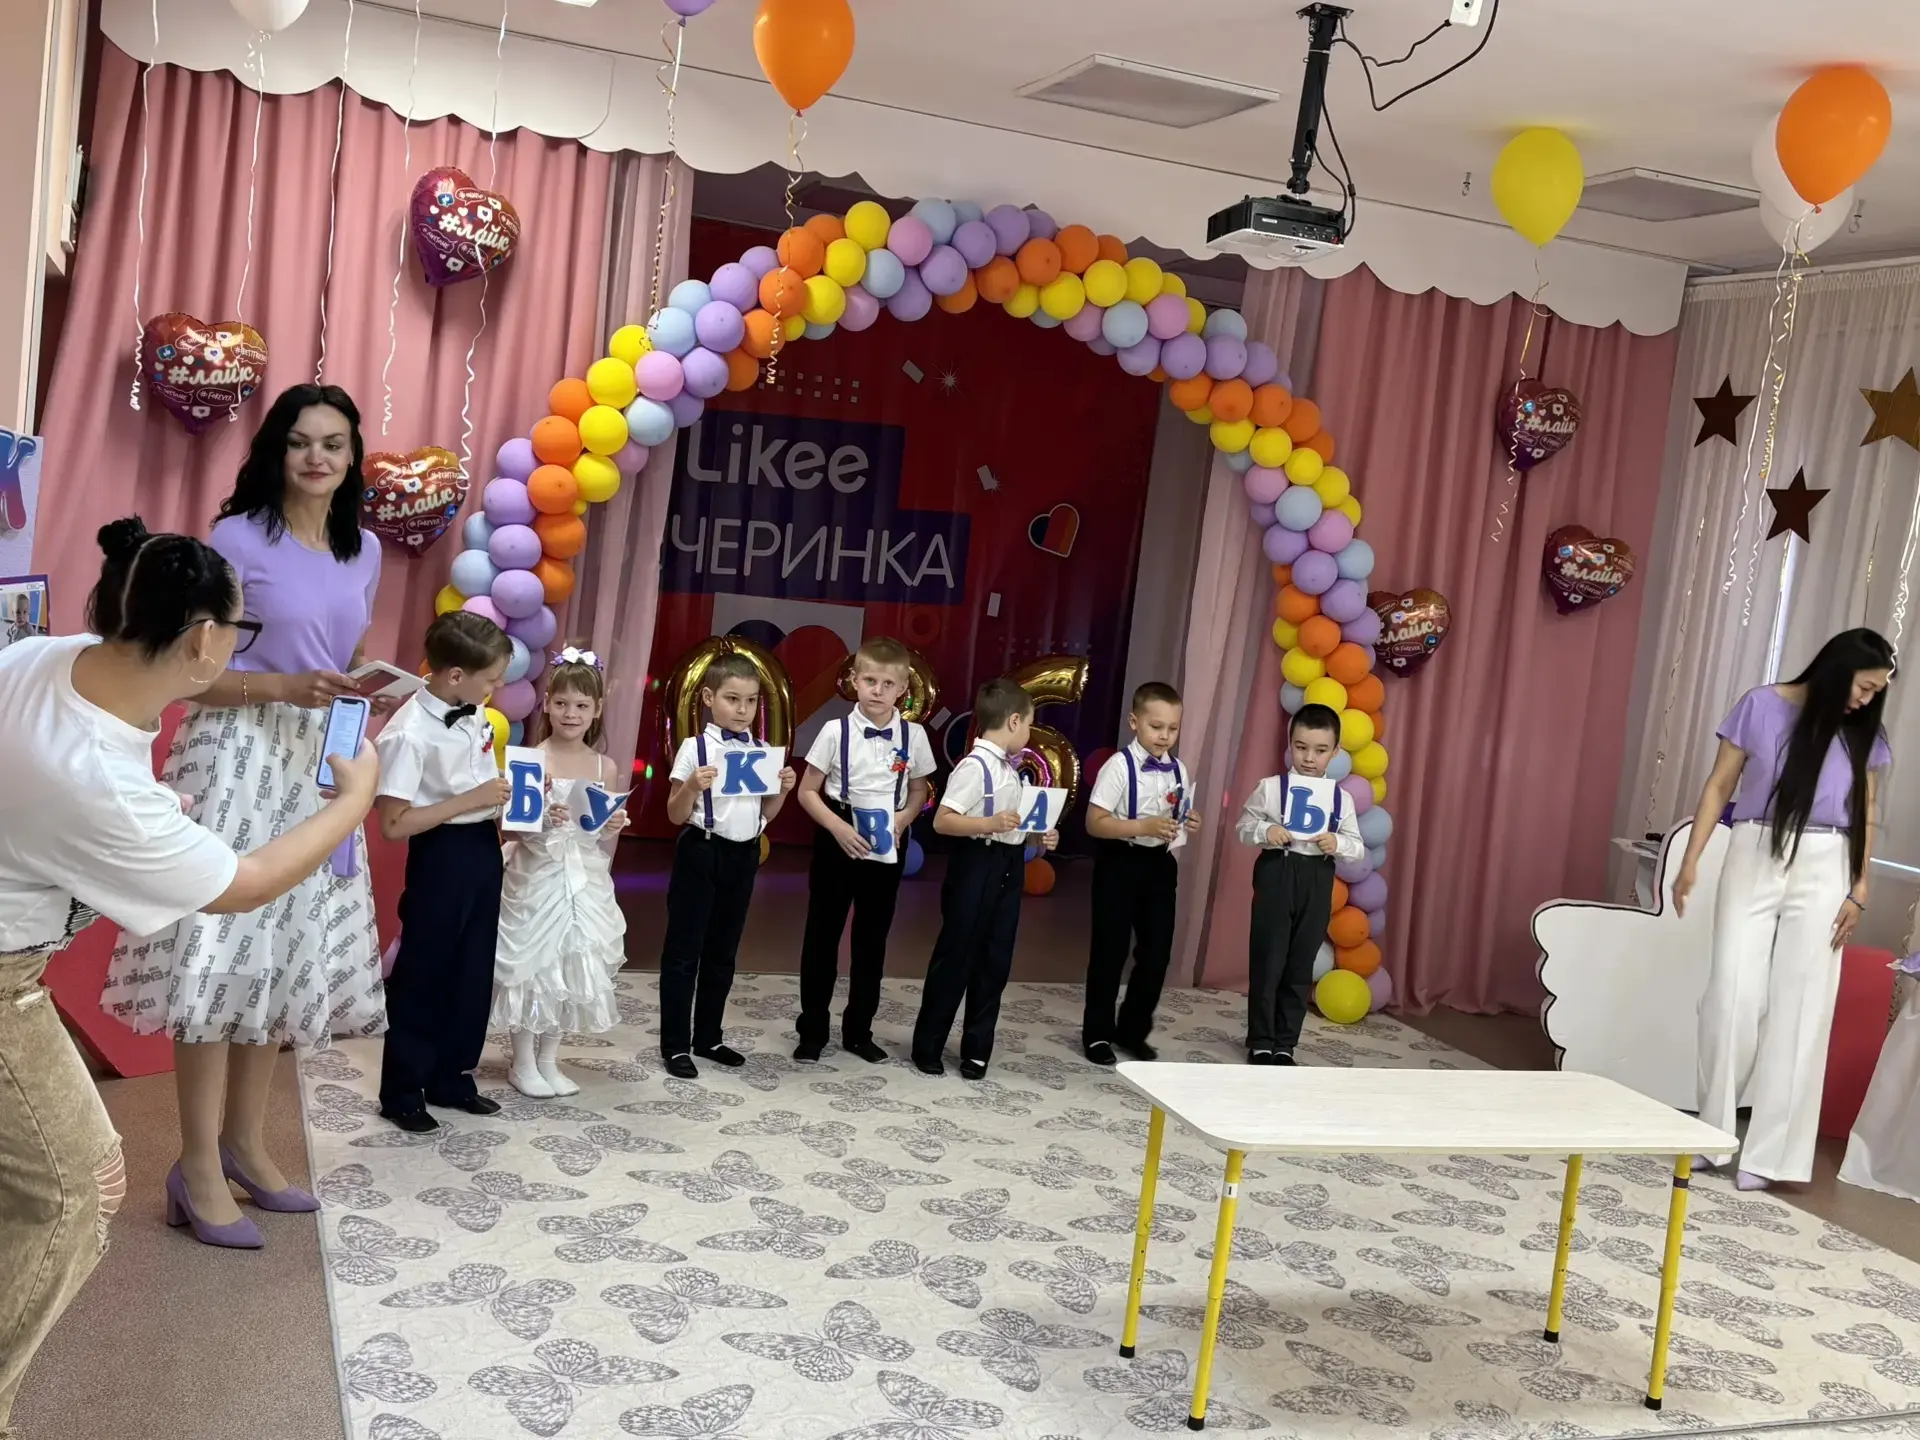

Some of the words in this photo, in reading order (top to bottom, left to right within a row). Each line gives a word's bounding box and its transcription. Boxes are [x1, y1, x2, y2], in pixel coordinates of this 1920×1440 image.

[168, 359, 254, 385] #лайк
[687, 419, 869, 493] Likee
[376, 484, 455, 522] #лайк
[1561, 562, 1622, 583] #лайк
[505, 760, 543, 823] Б
[721, 750, 769, 795] К
[853, 806, 893, 856] В
[1017, 790, 1048, 831] А
[1283, 785, 1325, 835] Ь
[232, 817, 252, 852] ENDI
